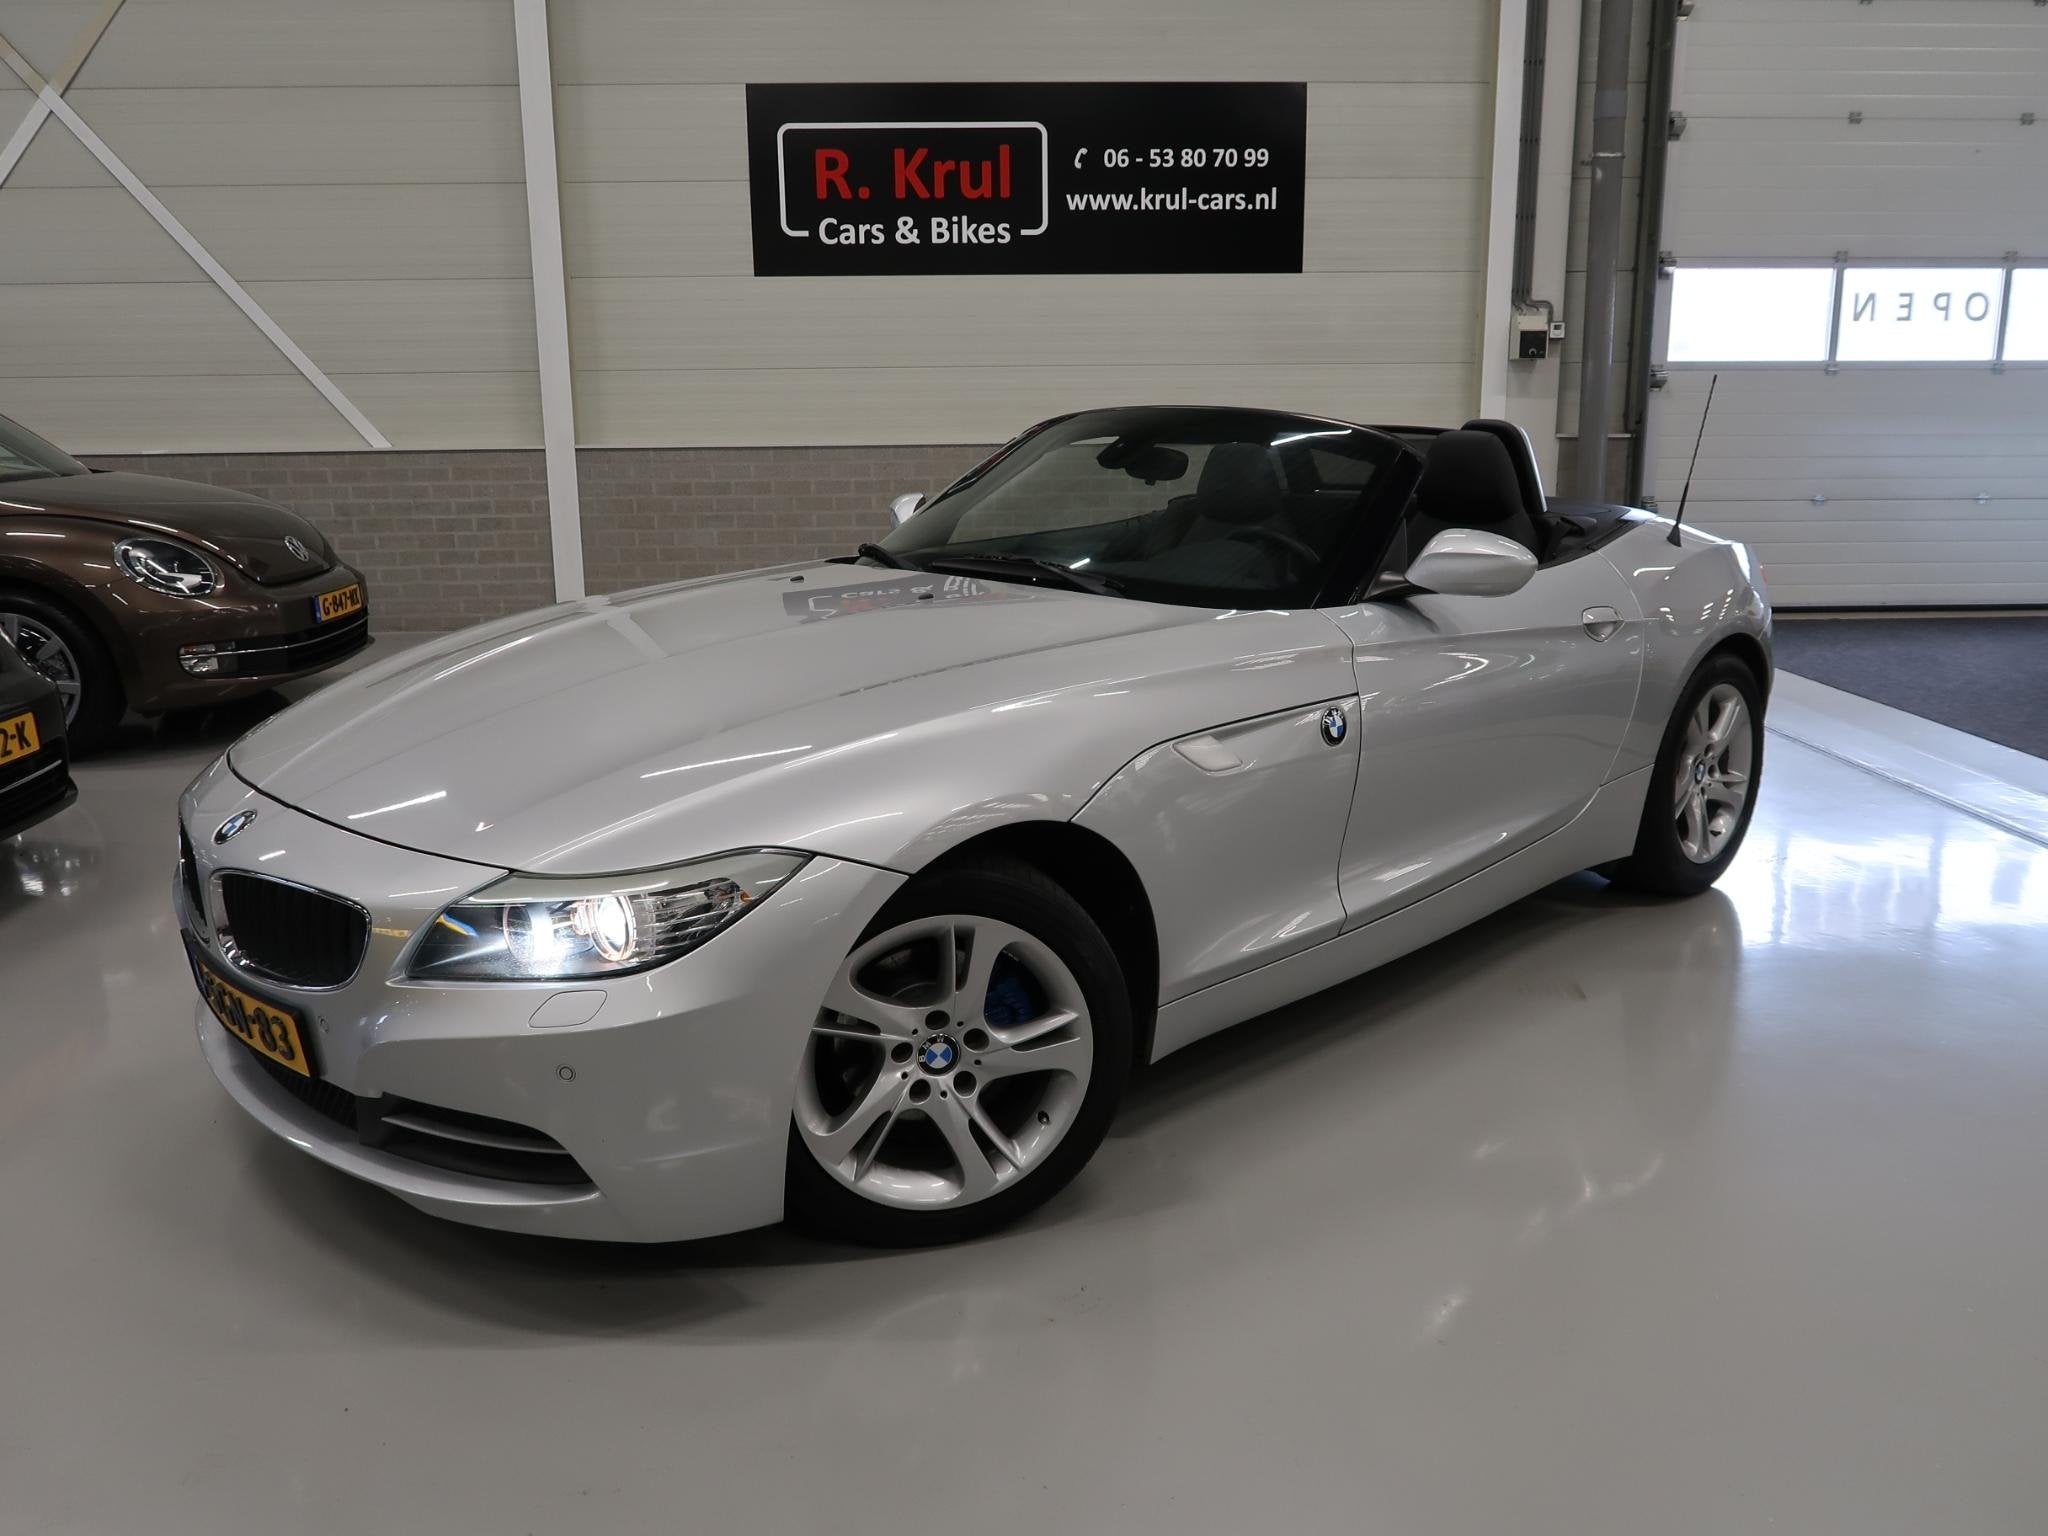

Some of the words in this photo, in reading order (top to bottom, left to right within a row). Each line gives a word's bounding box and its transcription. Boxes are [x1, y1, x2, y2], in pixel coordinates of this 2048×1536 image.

[1103, 148, 1130, 168] 06
[1149, 148, 1175, 168] 53
[1180, 148, 1207, 168] 80
[1212, 148, 1238, 168] 70
[1243, 147, 1270, 168] 99
[815, 148, 871, 200] R.
[894, 144, 1011, 200] Krul
[1065, 186, 1278, 211] www.krul-cars.nl
[818, 217, 885, 245] Cars
[895, 215, 921, 245] &
[930, 214, 1011, 245] Bikes
